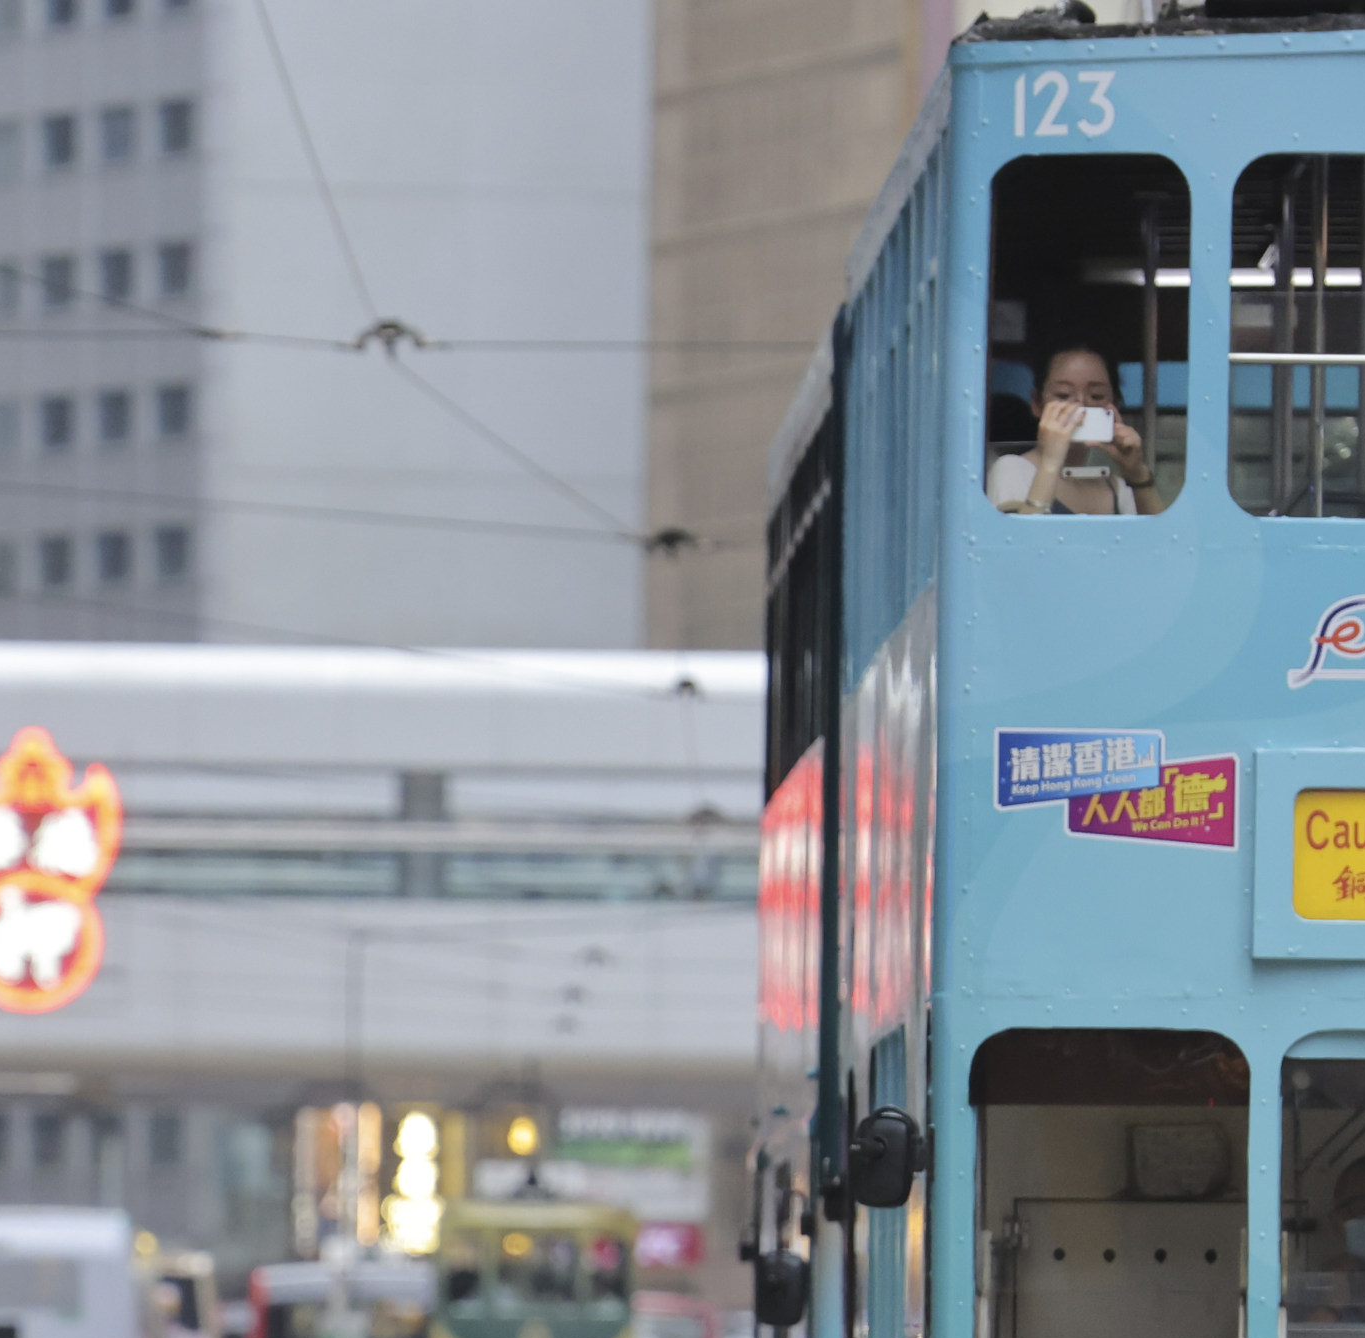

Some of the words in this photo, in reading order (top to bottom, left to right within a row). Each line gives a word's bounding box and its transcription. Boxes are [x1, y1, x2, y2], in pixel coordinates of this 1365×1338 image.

[1014, 70, 1116, 137] 123
[1010, 736, 1136, 782] 清潔香港
[1011, 782, 1039, 795] Keep
[1041, 778, 1071, 793] Hong
[1073, 775, 1102, 790] Kong
[1104, 773, 1137, 786] Clean
[1132, 820, 1149, 832] We
[1150, 819, 1171, 830] Can
[1173, 819, 1189, 829] Do
